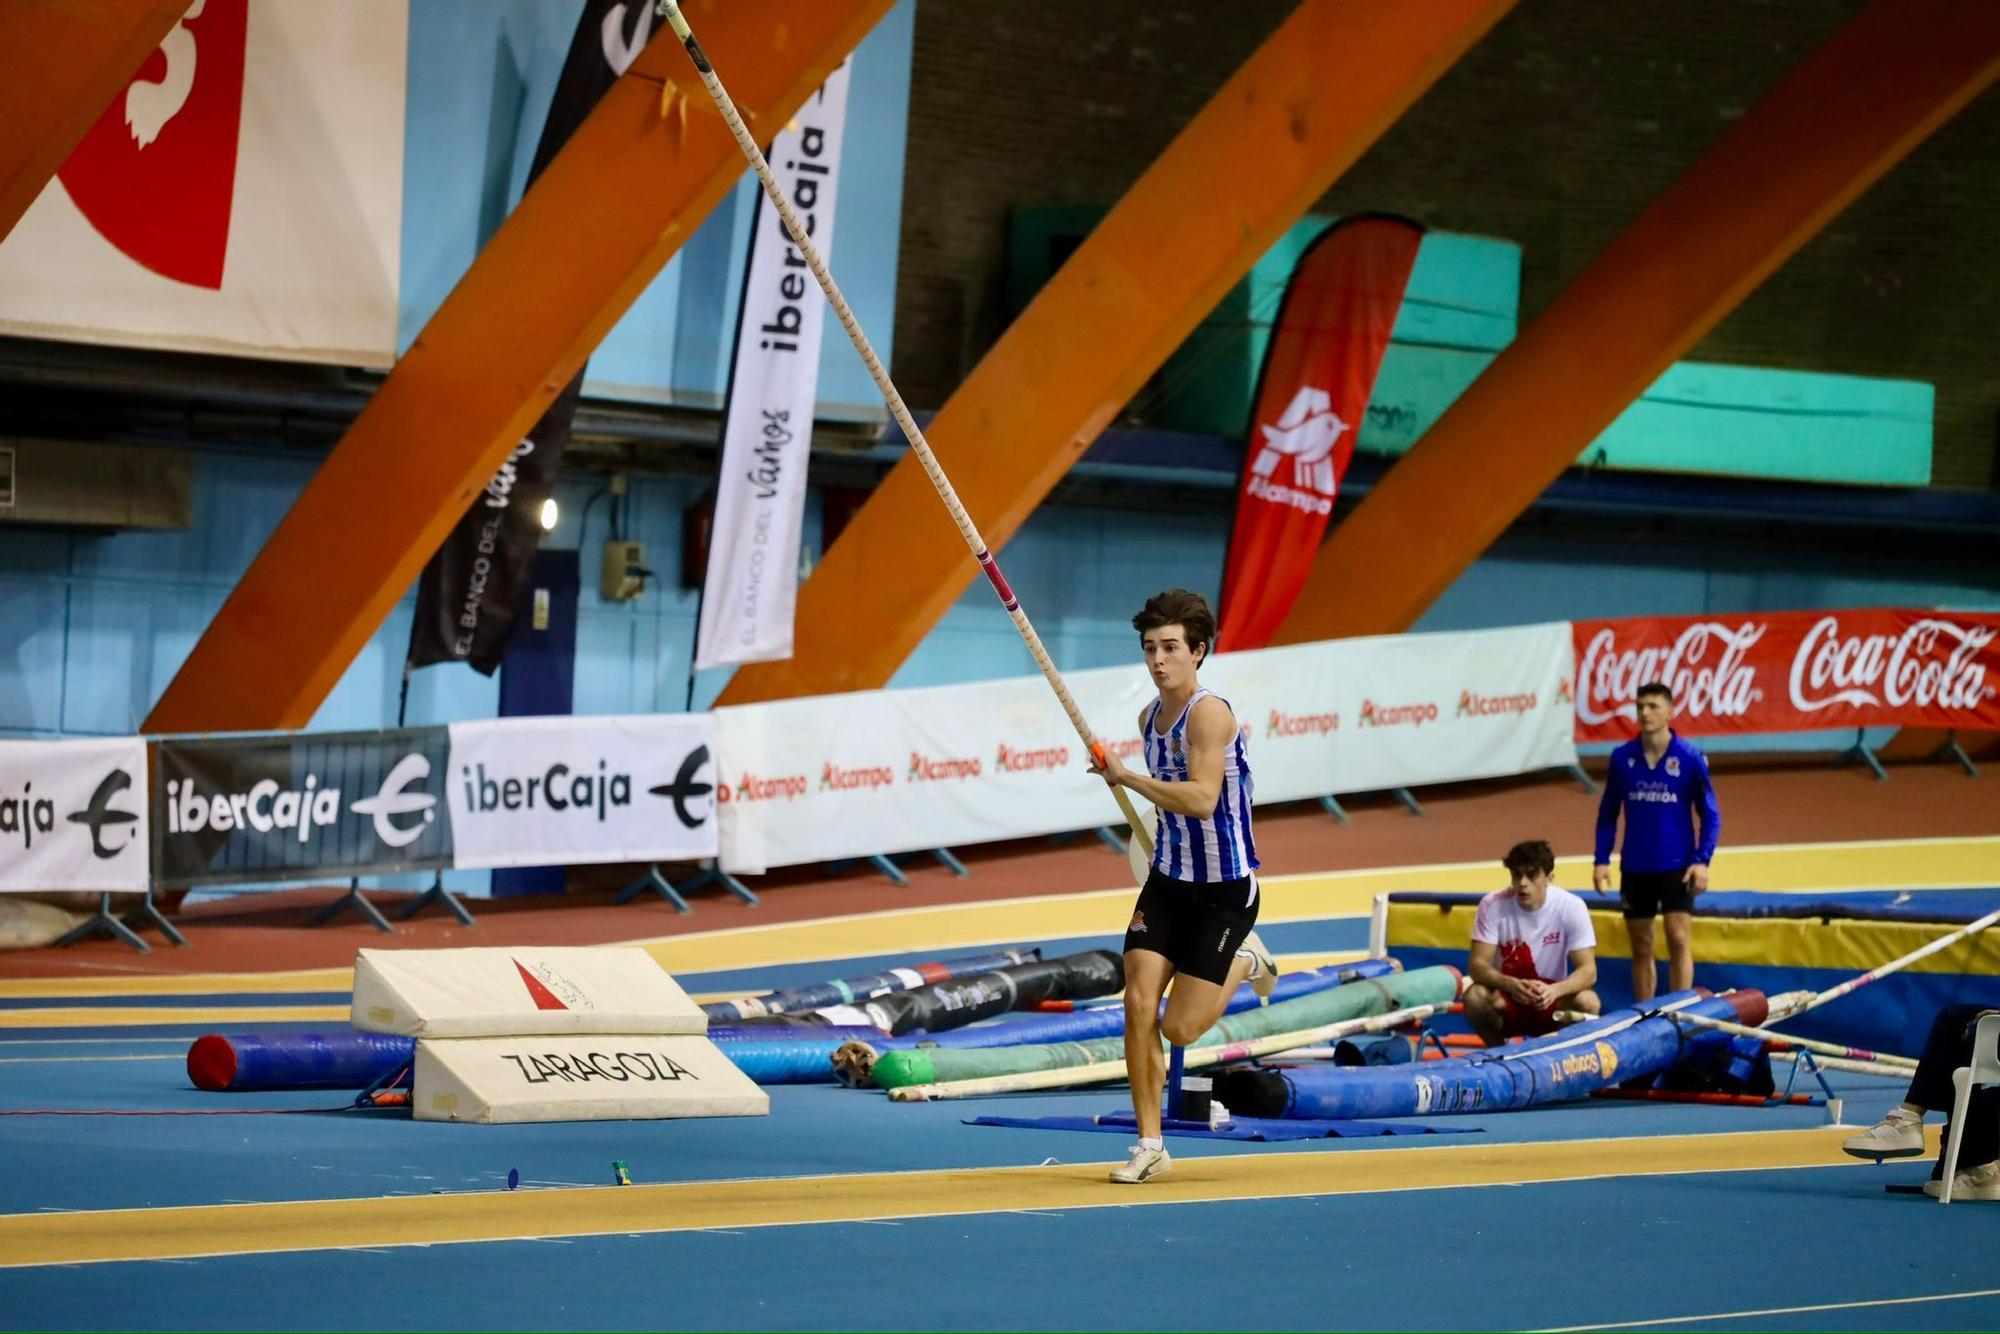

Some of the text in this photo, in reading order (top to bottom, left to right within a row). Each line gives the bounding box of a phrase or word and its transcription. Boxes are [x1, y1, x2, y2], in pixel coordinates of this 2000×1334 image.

[761, 126, 829, 352] iberCaja
[478, 518, 500, 554] DEL
[754, 509, 772, 545] DEL
[460, 557, 490, 629] BANCO
[744, 551, 766, 619] BANCO
[454, 633, 474, 656] EL
[742, 623, 757, 646] EL
[1358, 698, 1438, 728] Alcampo
[1456, 690, 1538, 718] Alcampo
[907, 752, 982, 783] Alcampo
[995, 744, 1068, 772] Alcampo
[463, 760, 632, 822] iberCaja
[736, 771, 806, 802] Alcampo
[818, 761, 893, 791] Alcampo
[168, 774, 340, 842] iberCaja
[501, 1053, 699, 1083] ZARAGOZA
